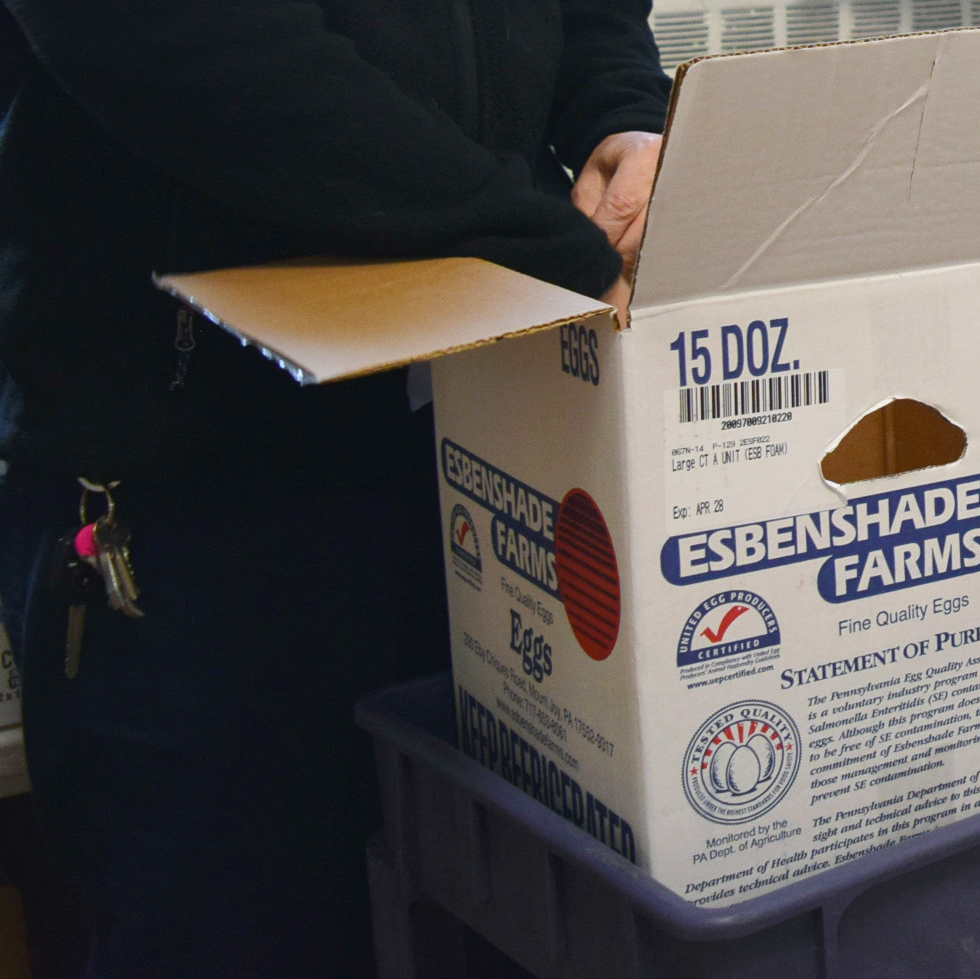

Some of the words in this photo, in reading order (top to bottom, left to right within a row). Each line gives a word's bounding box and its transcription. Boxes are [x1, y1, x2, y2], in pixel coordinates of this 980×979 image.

[560, 323, 599, 386] EGGS
[670, 328, 711, 387] 15
[721, 318, 800, 381] DOZ.
[671, 458, 696, 472] Large
[699, 454, 708, 468] CT
[713, 454, 718, 465] A
[721, 449, 740, 464] UNIT
[744, 447, 762, 461] (ESB
[765, 443, 788, 457] FOAM)
[446, 442, 554, 544] ESBENSHADE
[672, 506, 691, 520] Exp:
[696, 501, 711, 516] APR
[713, 499, 724, 512] 28
[496, 519, 559, 591] FARMS
[679, 611, 702, 653] UNITED
[703, 594, 726, 611] EGG
[730, 592, 778, 633] PRODUCERS
[838, 618, 871, 636] Fine
[876, 603, 928, 627] Quality
[933, 594, 970, 615] Eggs
[510, 608, 553, 683] Eggs
[698, 639, 760, 660] CERTIFIED
[780, 646, 900, 690] STATEMENT
[902, 639, 930, 659] OF
[687, 664, 774, 690] www.uepcertified.com
[807, 711, 817, 721] is
[820, 709, 829, 718] a
[832, 695, 884, 715] voluntary
[887, 683, 931, 701] industry
[933, 671, 978, 691] program
[808, 695, 827, 707] The
[830, 677, 901, 701] Pennsylvania
[903, 672, 923, 684] Egg
[925, 661, 964, 679] Quality
[691, 713, 734, 764] TESTED
[740, 708, 793, 741] QUALITY
[808, 712, 868, 735] Salmonella
[871, 697, 925, 719] Enteritidis
[927, 690, 948, 705] (SE)
[808, 736, 835, 749] eggs.
[838, 720, 885, 741] Although
[888, 715, 907, 728] this
[909, 703, 955, 725] program
[957, 696, 980, 709] does
[809, 753, 821, 762] to
[823, 748, 838, 759] be
[839, 742, 862, 757] free
[864, 735, 877, 749] of
[878, 732, 892, 744] SE
[894, 713, 971, 739] contamination,
[810, 750, 877, 776] commitment
[880, 744, 892, 758] of
[893, 729, 955, 753] Esbenshade
[692, 853, 707, 864] PA
[709, 848, 736, 860] Dept.
[738, 842, 748, 852] of
[750, 826, 802, 848] Agriculture
[706, 827, 756, 849] Monitored
[758, 824, 770, 836] by
[772, 820, 788, 831] the
